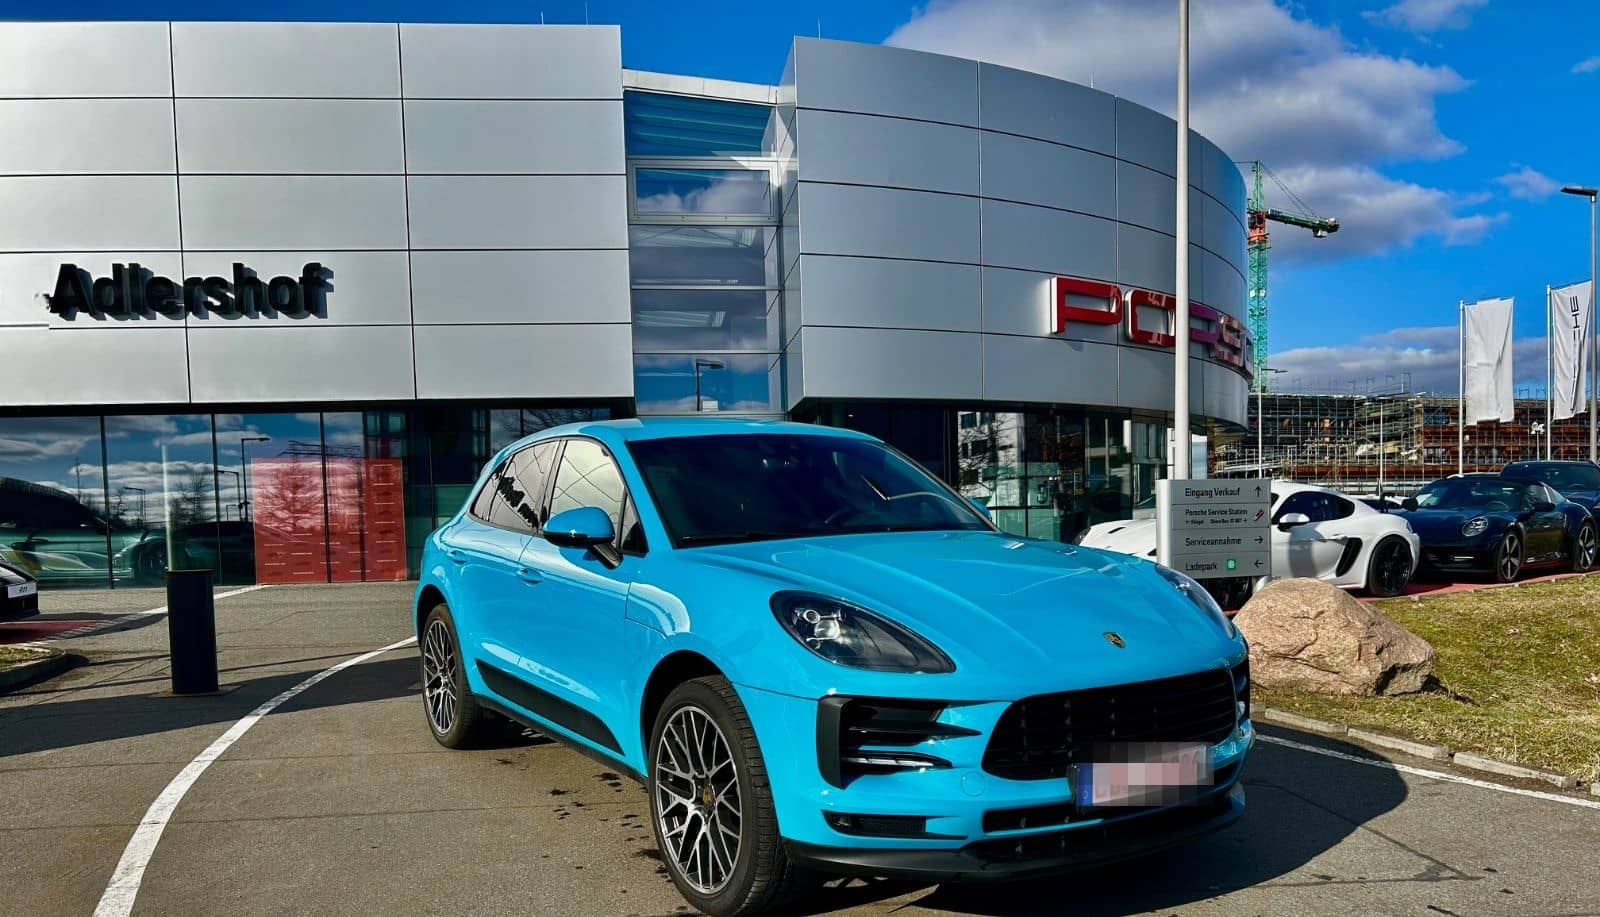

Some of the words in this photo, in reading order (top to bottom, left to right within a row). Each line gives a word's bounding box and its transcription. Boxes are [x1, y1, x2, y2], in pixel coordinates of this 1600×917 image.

[50, 262, 332, 319] Adlershof
[1185, 488, 1213, 498] Eingang
[1214, 487, 1240, 496] Verkauf
[1185, 536, 1242, 547] Serviceannahme
[1185, 561, 1218, 573] Ladepark
